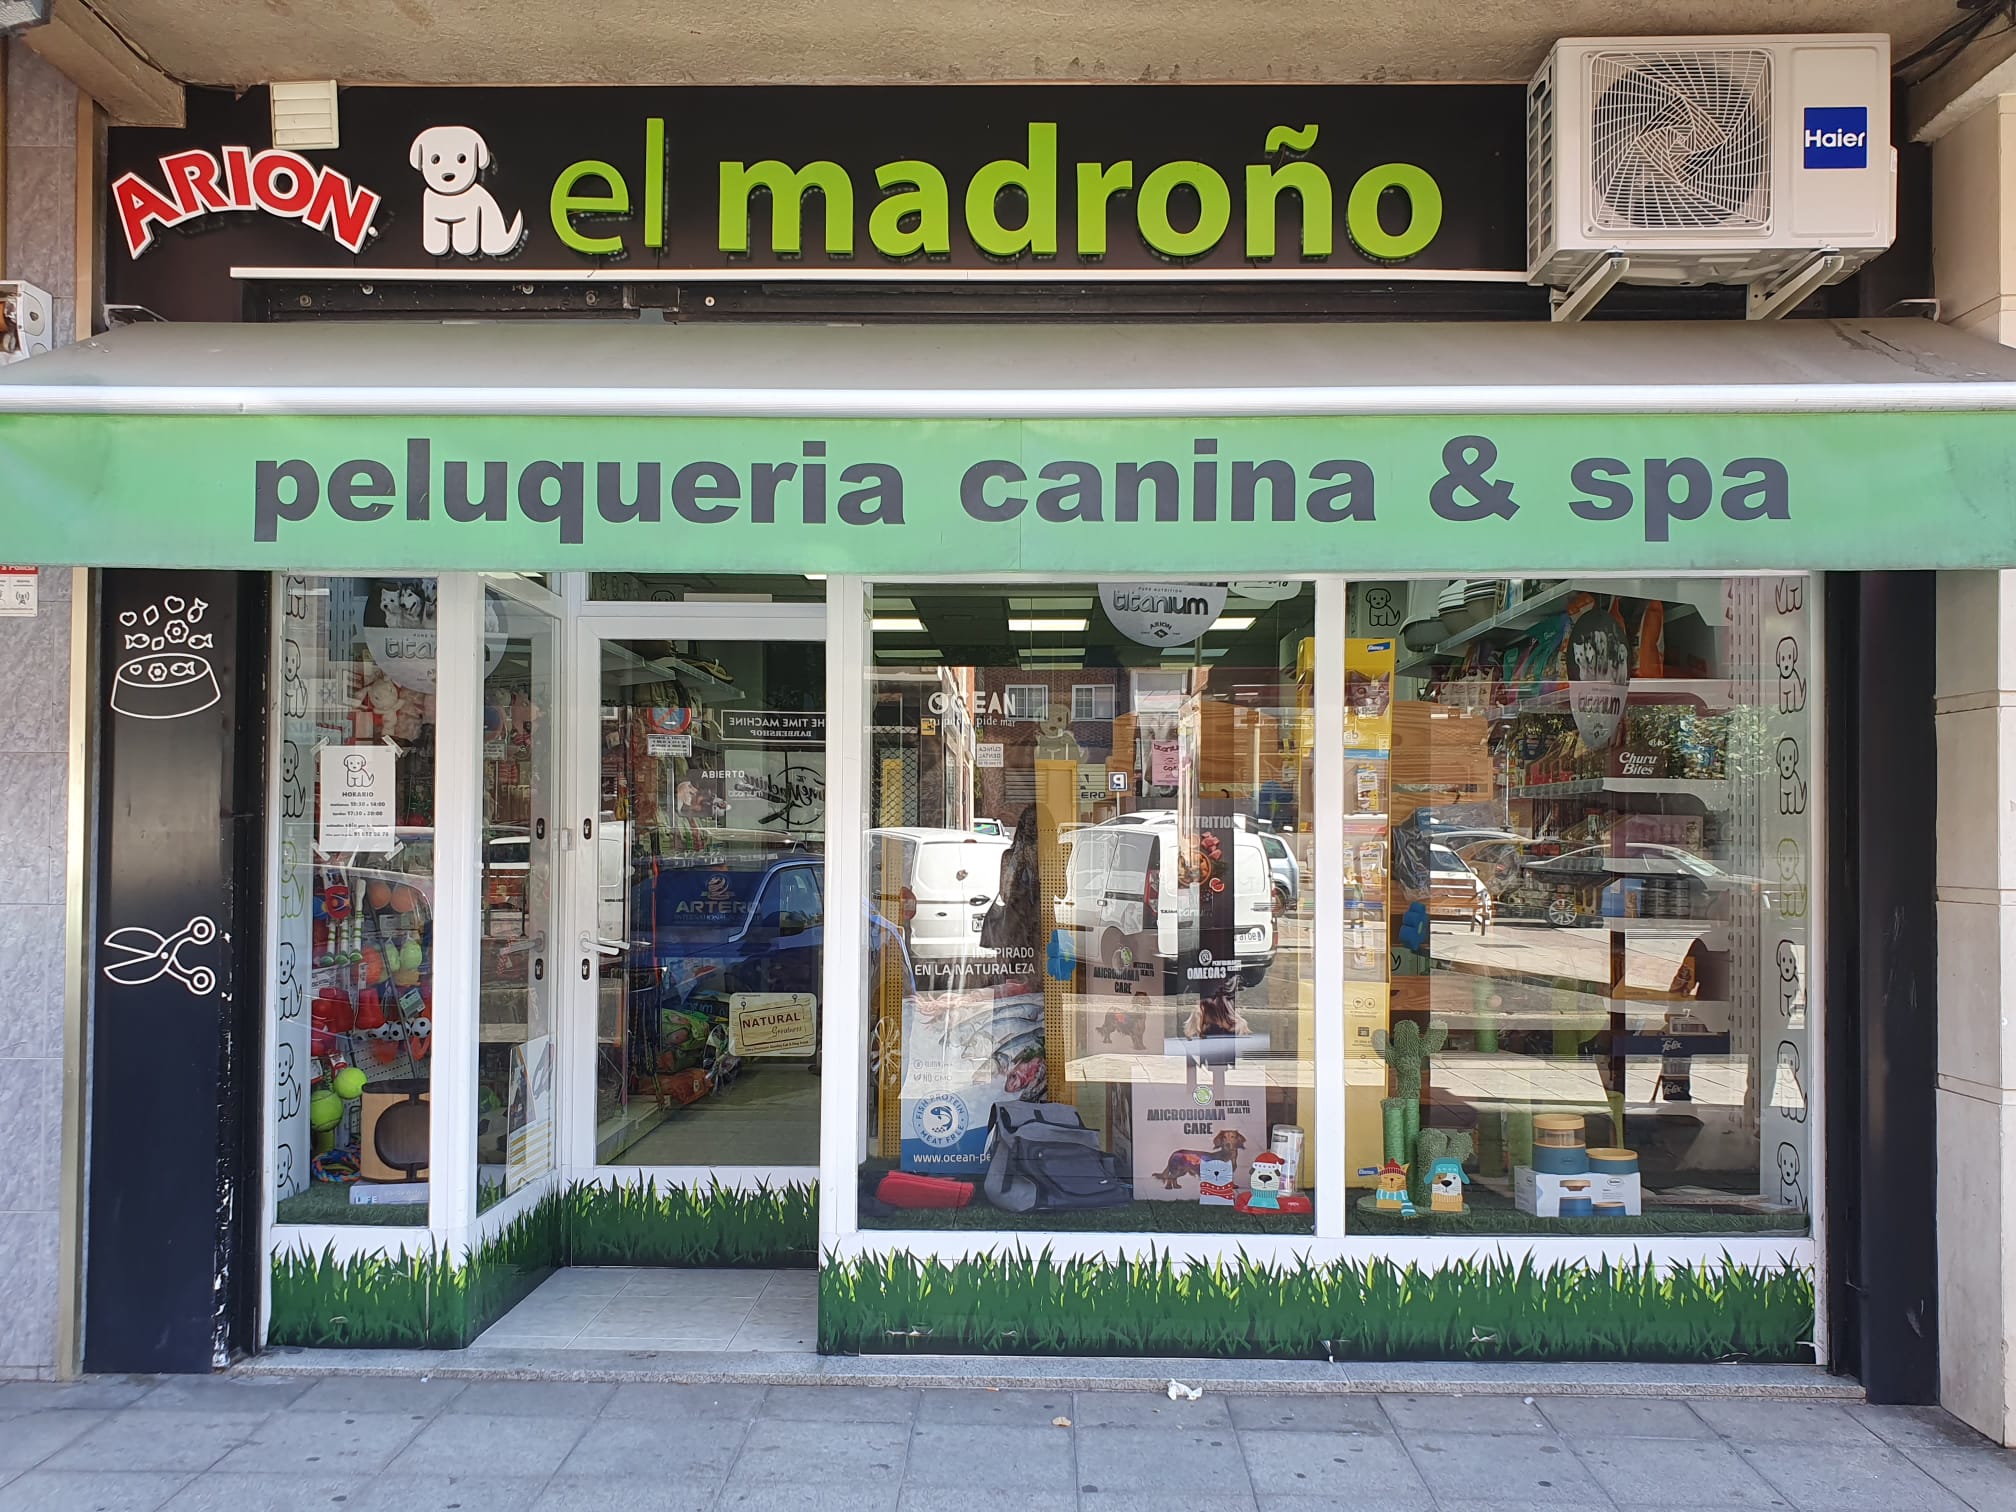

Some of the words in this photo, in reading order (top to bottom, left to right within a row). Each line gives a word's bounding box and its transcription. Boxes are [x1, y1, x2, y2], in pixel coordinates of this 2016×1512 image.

[1805, 128, 1866, 148] Haier
[550, 117, 665, 255] el
[718, 121, 1443, 260] madroño
[112, 145, 380, 260] ARION
[254, 438, 906, 544] peluqueria
[960, 438, 1377, 523] canina
[1429, 434, 1521, 522] &
[1568, 456, 1791, 543] spa
[1113, 590, 1209, 615] titanium
[1619, 752, 1658, 765] Churu
[701, 770, 745, 779] ABIERTO
[1622, 763, 1655, 775] Bites
[1081, 791, 1106, 799] ERO
[915, 965, 931, 976] EN
[935, 965, 951, 976] LA
[955, 963, 1036, 976] NATURALEZA
[1114, 982, 1132, 994] CARE
[742, 1012, 801, 1029] NATURAL
[1147, 1108, 1226, 1121] MICROBIOMA
[1183, 1122, 1213, 1135] CARE
[920, 1130, 942, 1145] MEAT
[913, 1153, 992, 1164] www.ocean-pe
